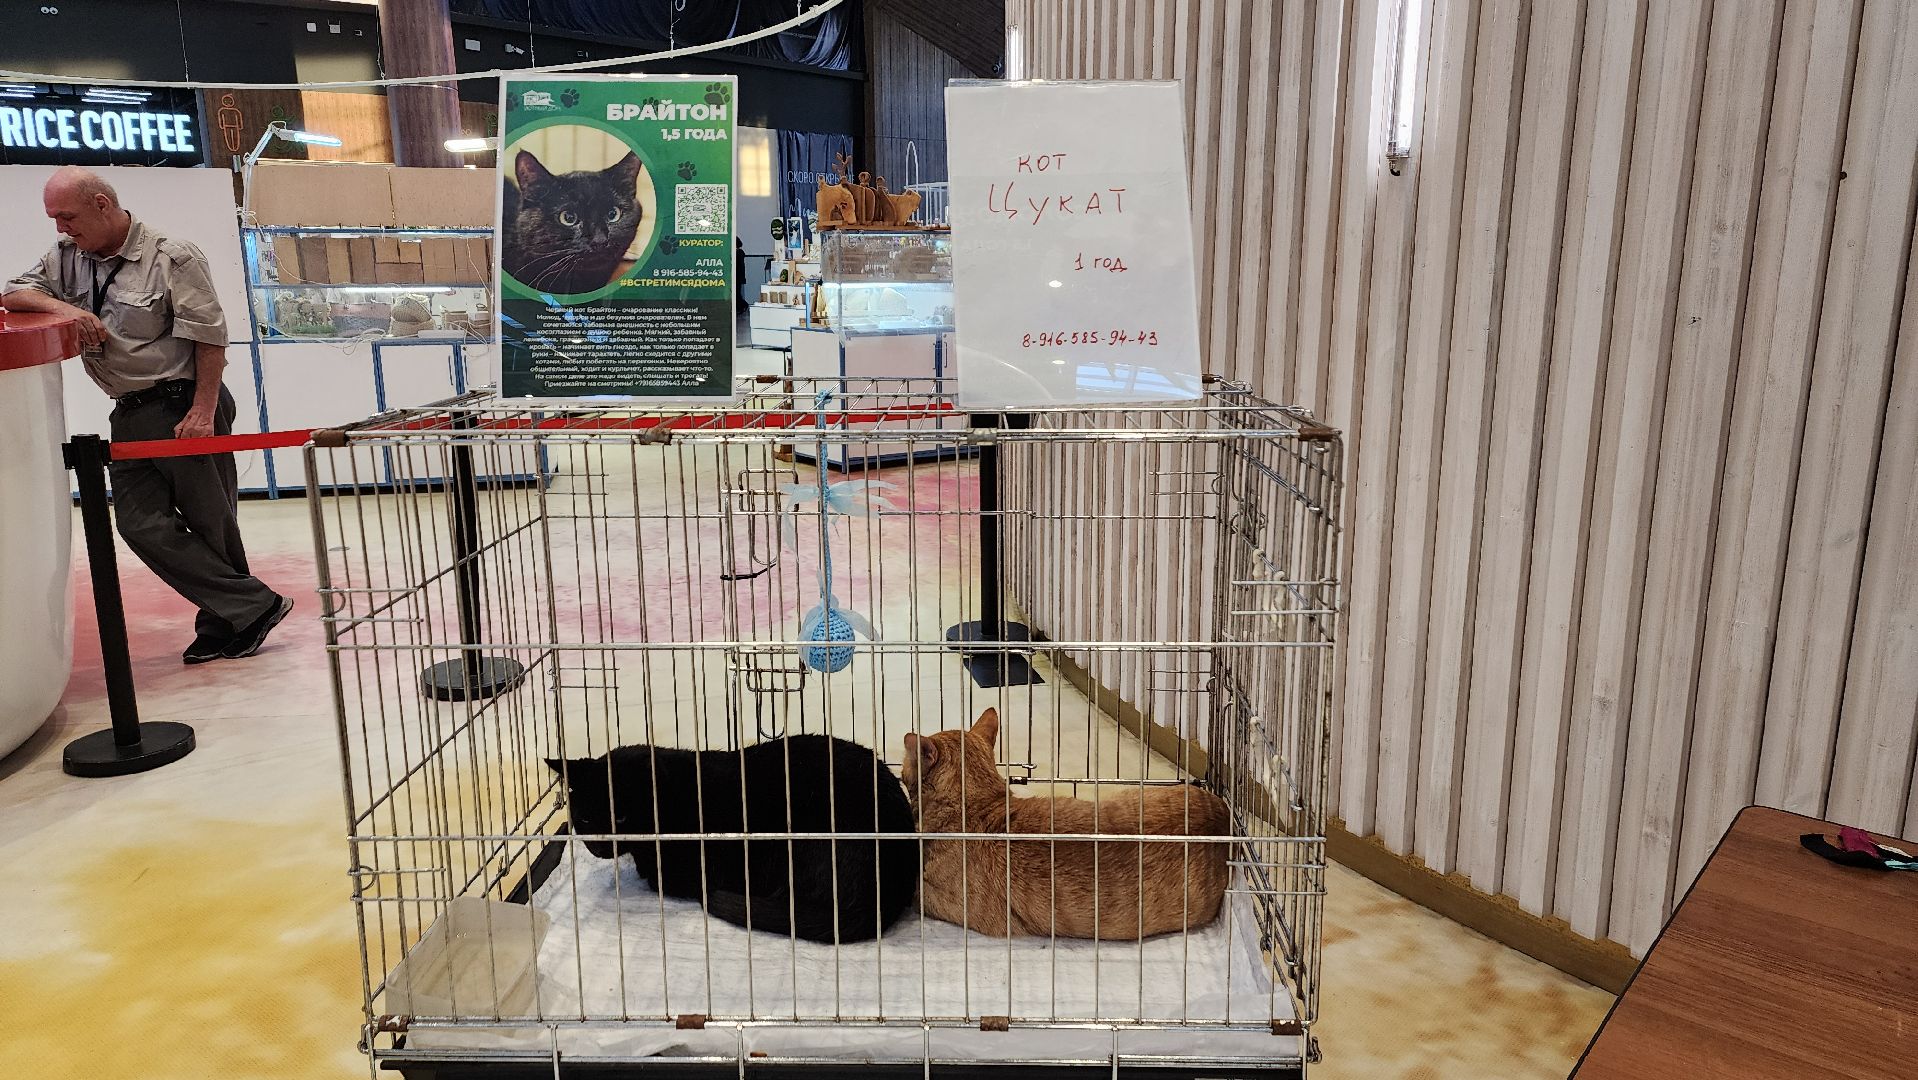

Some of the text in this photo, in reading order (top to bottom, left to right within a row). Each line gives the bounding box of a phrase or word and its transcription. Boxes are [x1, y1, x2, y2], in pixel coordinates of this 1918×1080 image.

[606, 99, 727, 121] БРАЙТОН
[0, 106, 194, 152] RICE COFFEE
[661, 128, 728, 141] 1,5 ГОДА
[787, 170, 814, 184] СКОРО
[988, 181, 1127, 225] ЦУКАТ
[679, 239, 724, 247] КУРАТОР:
[695, 258, 724, 267] АЛЛА
[1074, 252, 1084, 271] 1
[653, 268, 724, 277] 8 916-585-94-43
[620, 278, 726, 288] #ВСТРЕТИМСЯДОМА
[587, 306, 617, 314] Брайтон
[1022, 331, 1158, 348] 8-916-585-94-43
[544, 380, 586, 388] Приезжайте
[587, 380, 597, 388] на
[681, 380, 700, 388] Алла
